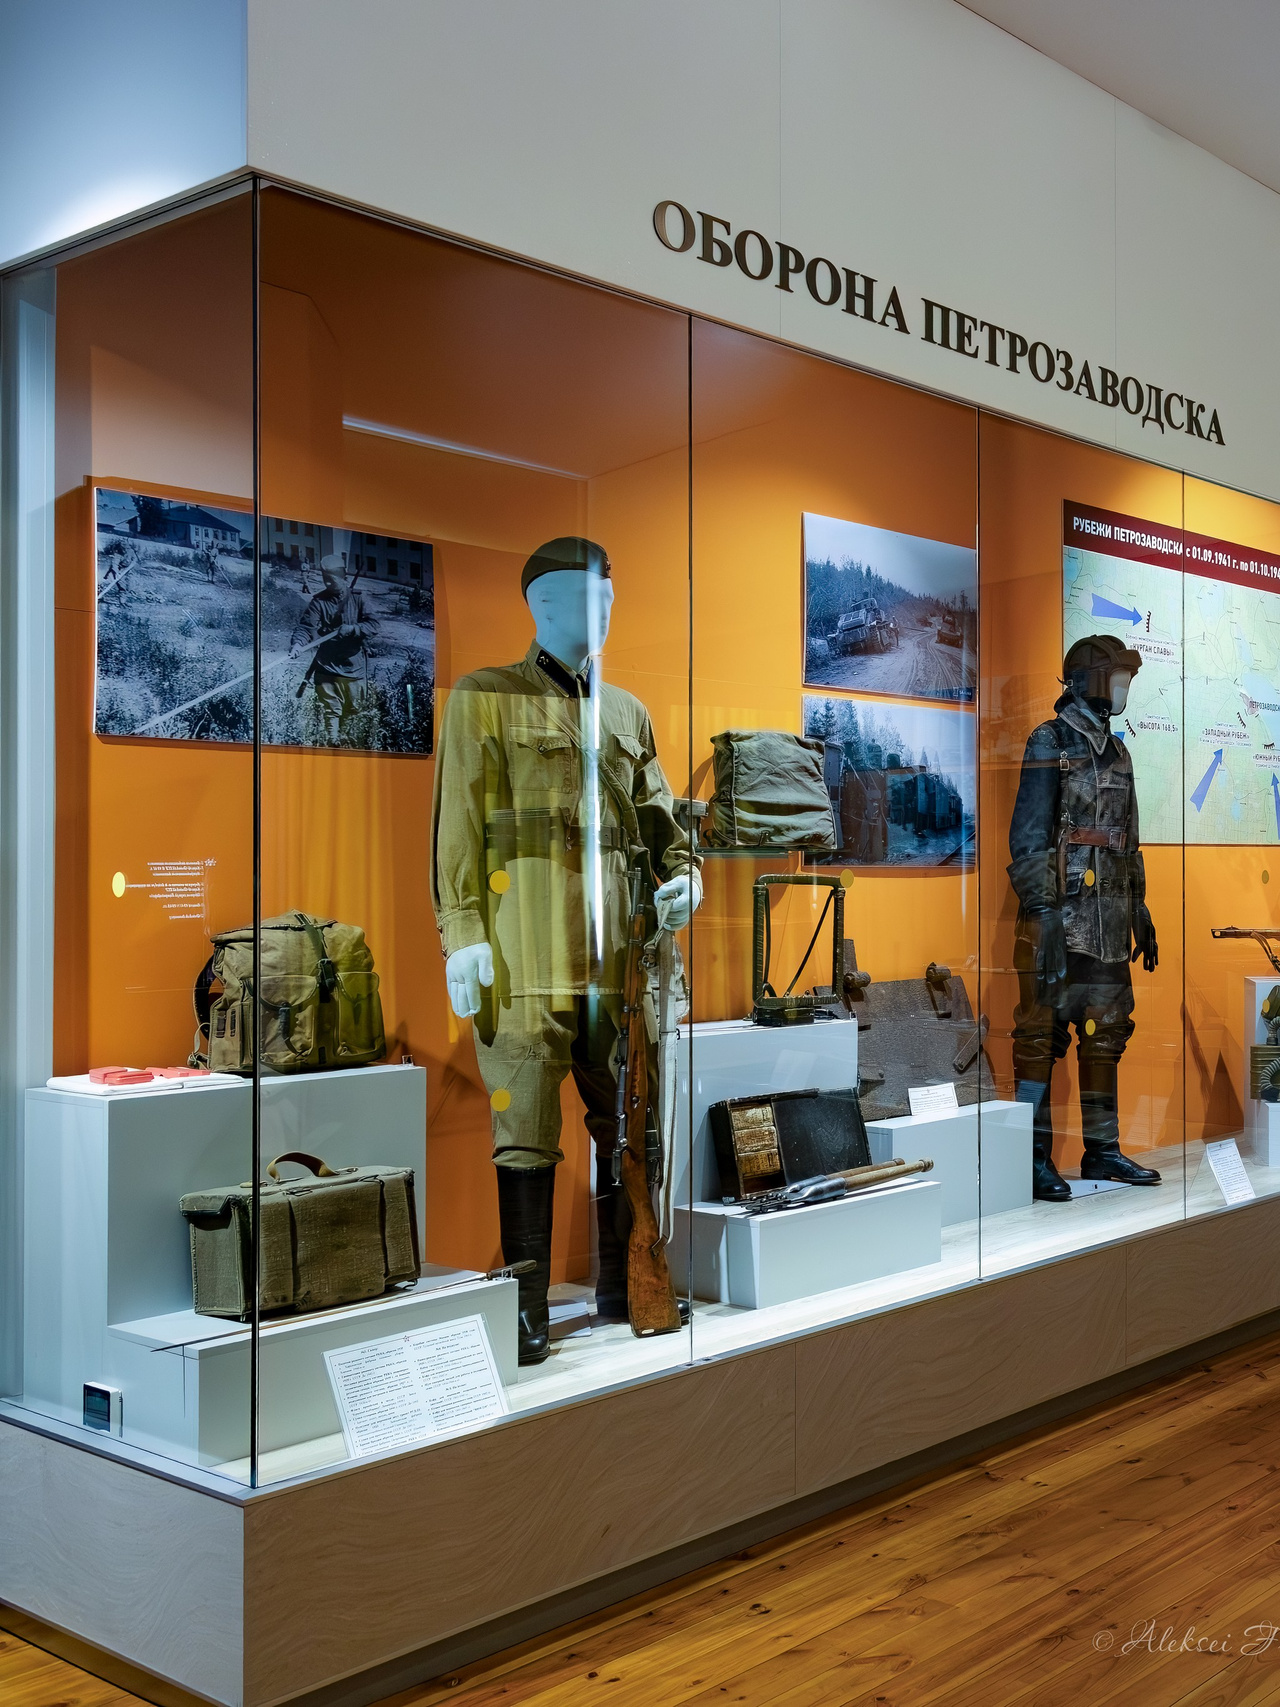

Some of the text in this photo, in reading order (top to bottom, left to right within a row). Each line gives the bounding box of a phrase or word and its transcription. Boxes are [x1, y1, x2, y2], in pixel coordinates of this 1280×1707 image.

[652, 199, 1227, 447] ОБОРОНА ПЕТРОЗАВОДСКА
[1073, 516, 1111, 539] РУБЕЖИ
[1114, 526, 1183, 555] ПЕТРОЗАВОДСКА
[1185, 547, 1191, 557] с
[1192, 546, 1231, 568] 01.09.1941
[1232, 559, 1239, 570] г.
[1240, 561, 1249, 572] по
